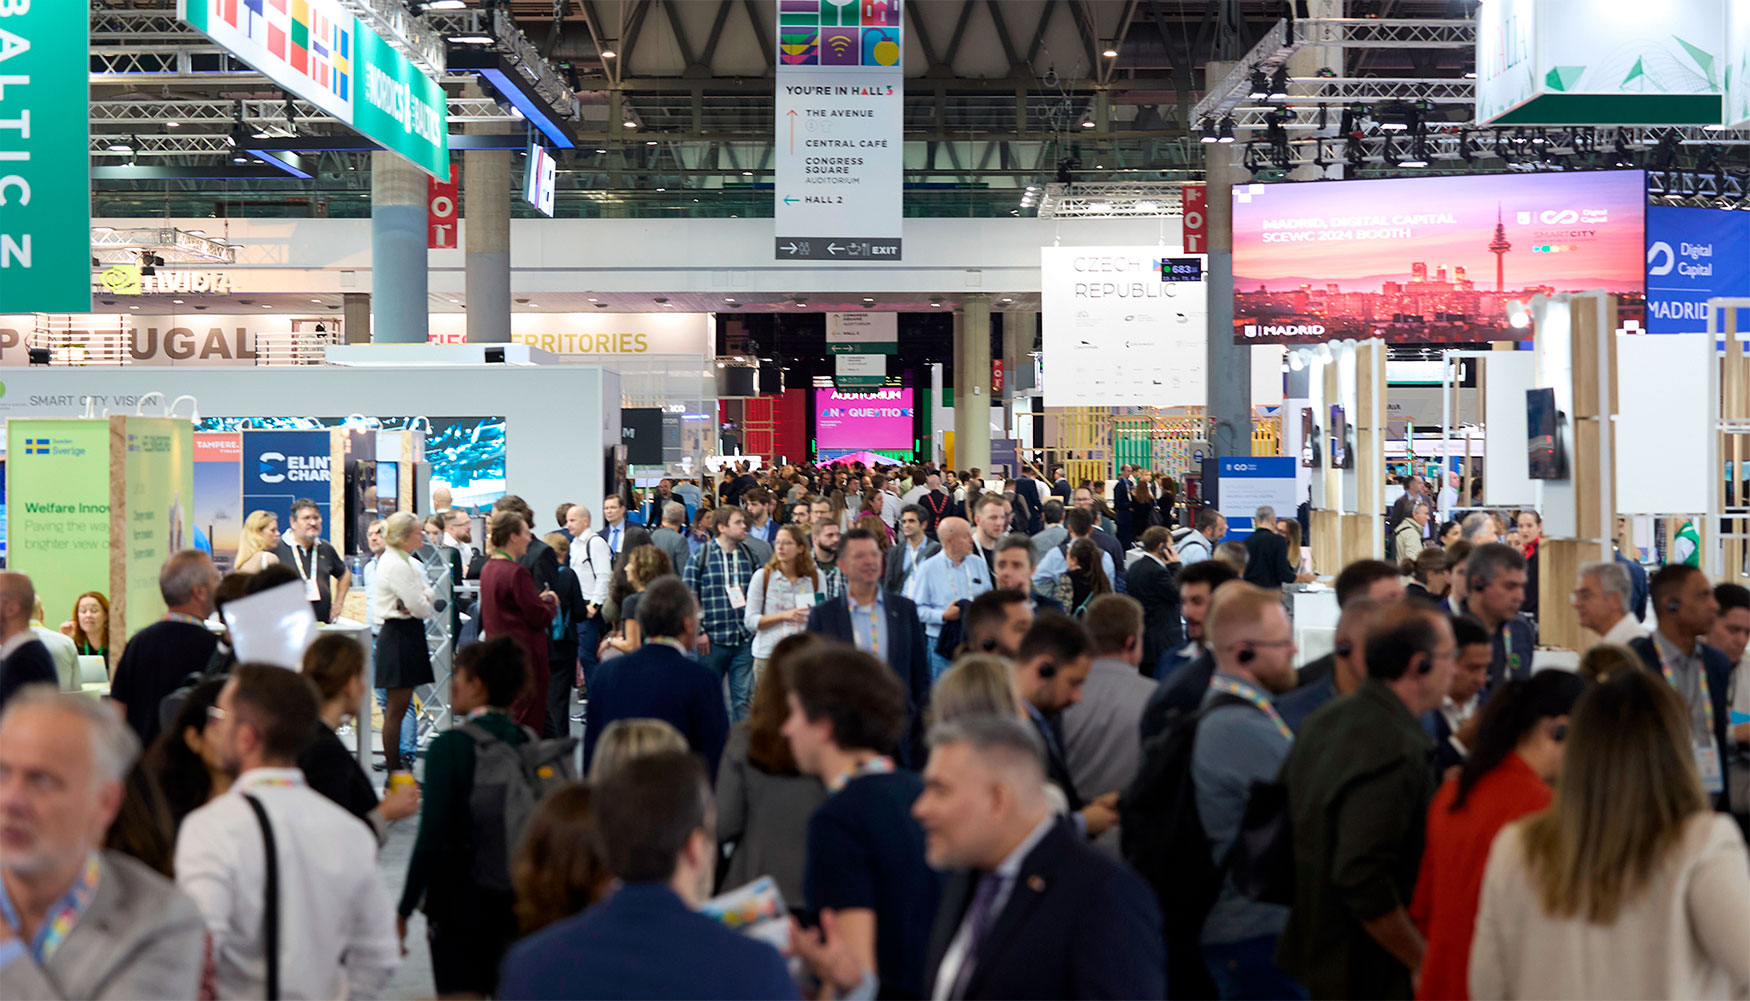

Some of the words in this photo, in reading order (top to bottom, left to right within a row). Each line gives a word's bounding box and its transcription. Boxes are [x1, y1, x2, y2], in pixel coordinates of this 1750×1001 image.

[835, 87, 847, 95] IN
[852, 87, 883, 96] HALL
[806, 109, 826, 117] THE
[830, 109, 874, 117] AVENUE
[859, 138, 888, 148] CAFÉ
[805, 157, 864, 165] CONGRESS
[805, 166, 849, 174] SQUARE
[805, 196, 833, 204] HALL
[837, 196, 843, 204] 2
[1330, 215, 1389, 228] DIGITAL
[1391, 213, 1456, 226] CAPITAL
[1262, 231, 1315, 243] SCEWC
[1317, 230, 1354, 241] 2024
[1356, 228, 1411, 240] BOOTH
[872, 246, 898, 255] EXIT
[1680, 243, 1712, 260] Digital
[1074, 257, 1140, 272] CZECH
[1677, 262, 1712, 279] Capital
[1075, 283, 1177, 298] REPUBLIC
[1263, 325, 1326, 336] MADRID
[30, 396, 74, 406] SMART
[53, 447, 85, 456] Sverige
[25, 503, 75, 513] Welfare
[25, 519, 64, 534] Paving
[66, 519, 86, 531] the
[25, 538, 69, 552] brighter
[72, 540, 98, 550] view
